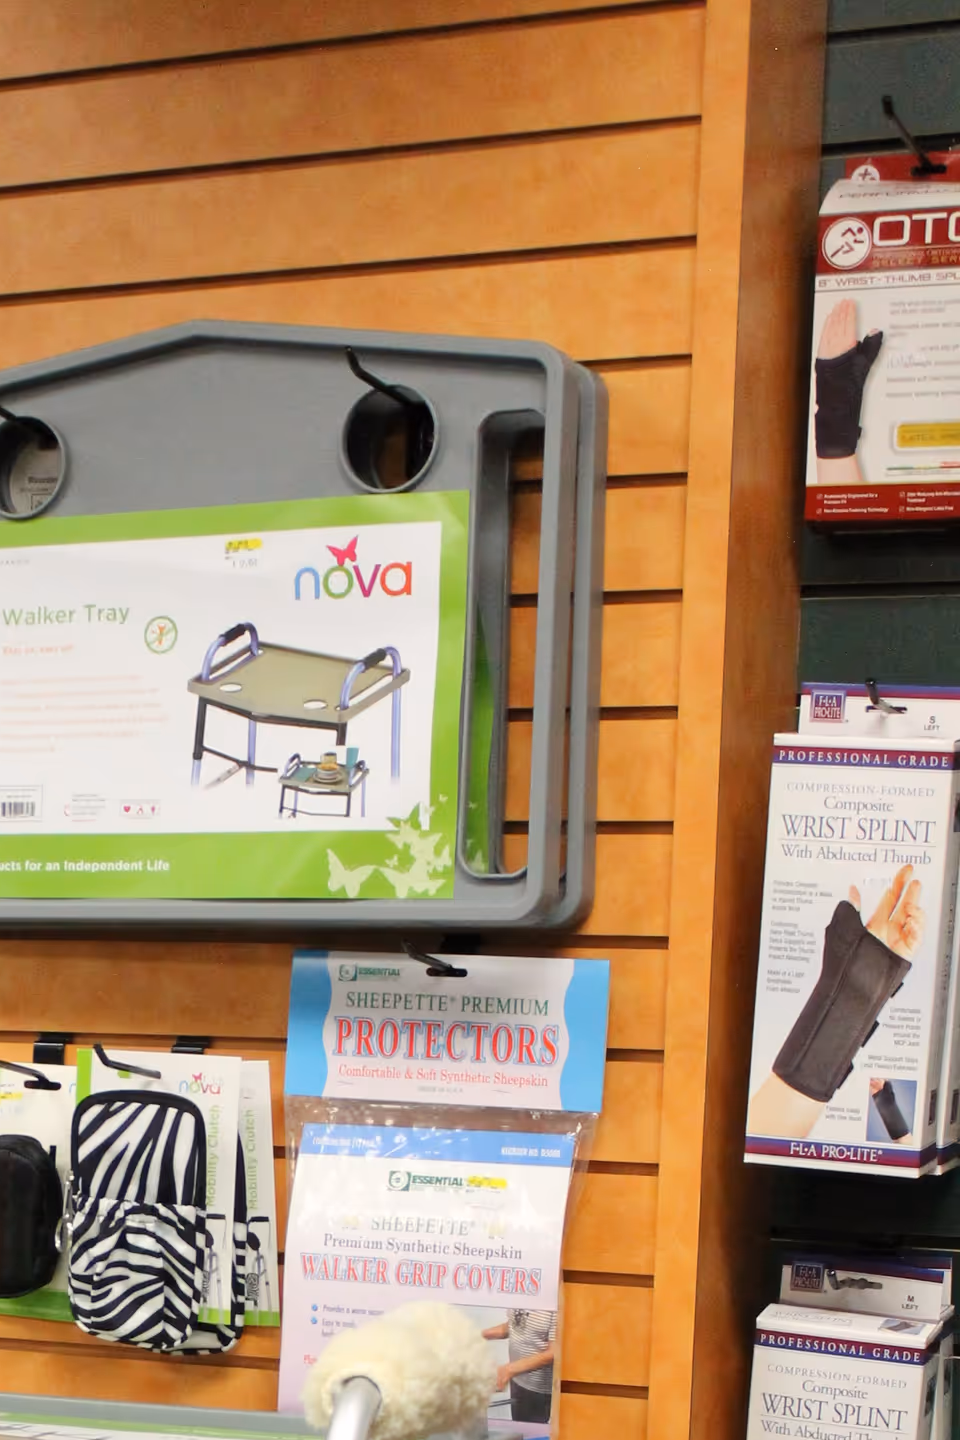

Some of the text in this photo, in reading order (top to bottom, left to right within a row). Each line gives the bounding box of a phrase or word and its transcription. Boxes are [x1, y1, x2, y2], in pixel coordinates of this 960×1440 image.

[294, 561, 412, 600] nova
[2, 604, 130, 626] Walker Tray
[929, 716, 936, 724] S
[779, 750, 948, 767] PROFESSIONAL GRADE
[786, 781, 936, 797] COMPRESSION-FORMED
[824, 795, 894, 814] Composite
[782, 814, 937, 844] WRIST SPLINT
[781, 844, 932, 865] With Abducted Thumb
[25, 860, 41, 872] for
[45, 862, 60, 872] an
[64, 860, 143, 873] Independent
[146, 860, 170, 871] Life
[461, 994, 549, 1017] PREMIUM
[333, 1016, 559, 1067] PROTECTORS
[338, 1065, 548, 1089] Comfortable & Soft Synthetic Sheepskin
[207, 1104, 220, 1207] Mobility Clutch
[244, 1110, 258, 1210] Mobility Clutch
[412, 1175, 464, 1187] ESSENTIAL
[323, 1233, 522, 1260] Premium Synthetic Sheepskin
[300, 1253, 541, 1296] WALKER GRIP COVERS
[760, 1334, 921, 1362] PROFESSIONAL GRADE
[767, 1364, 907, 1389] COMPRESSION-FORMED
[802, 1379, 868, 1400] Composite
[761, 1392, 908, 1431] WRIST SPLINT
[760, 1420, 791, 1436] With
